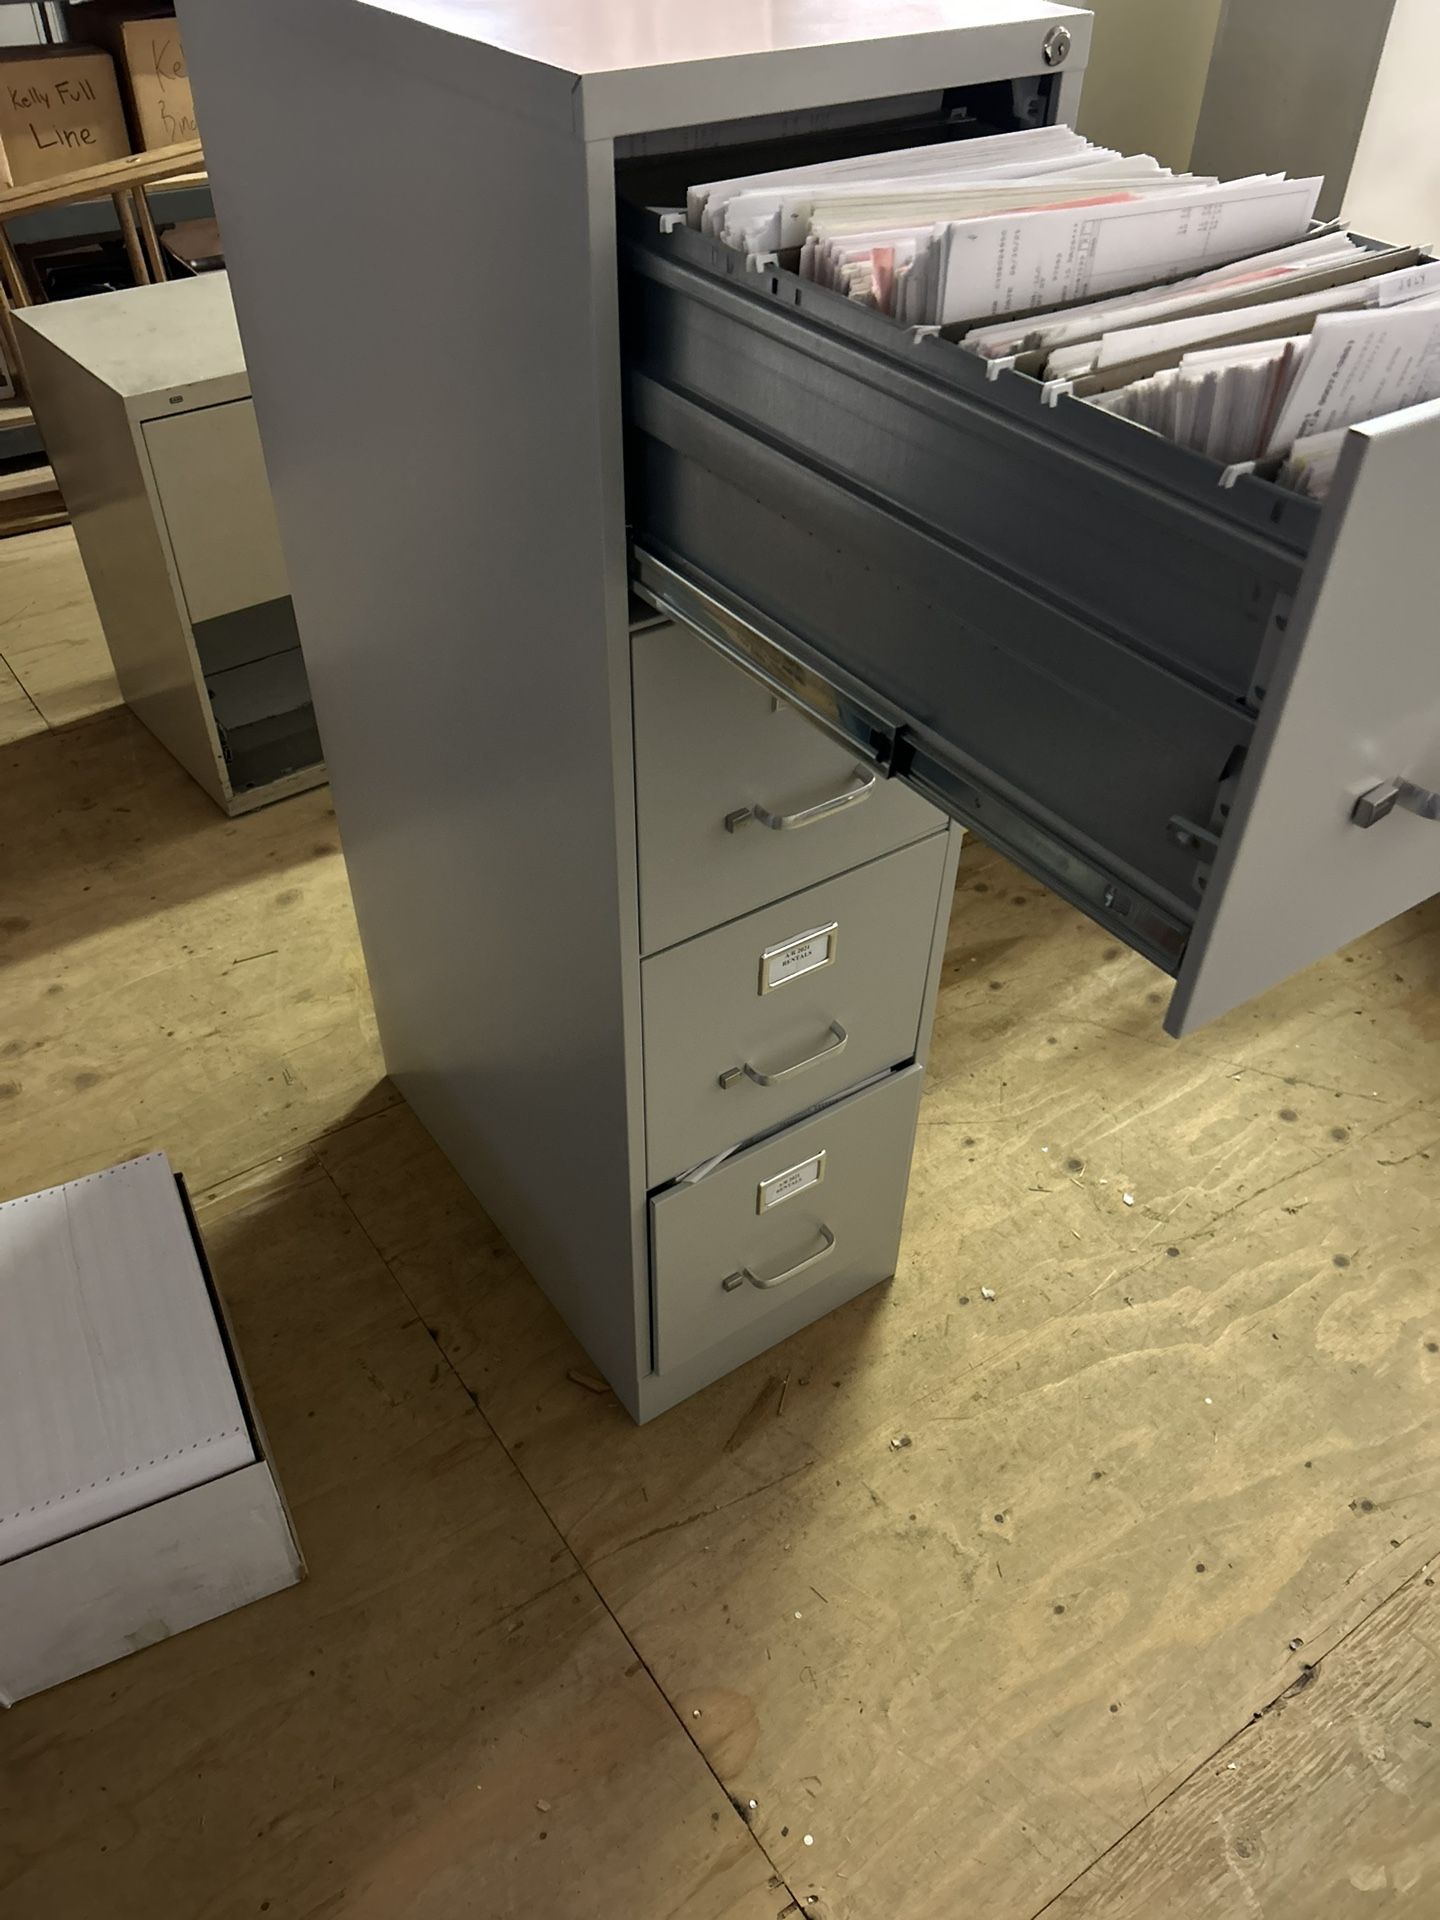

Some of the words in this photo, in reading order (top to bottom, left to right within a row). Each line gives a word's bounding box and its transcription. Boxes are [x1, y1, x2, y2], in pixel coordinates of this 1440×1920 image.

[7, 85, 50, 111] Kelly
[55, 79, 96, 105] Full
[29, 122, 97, 150] Line
[782, 951, 812, 967] RENTALS
